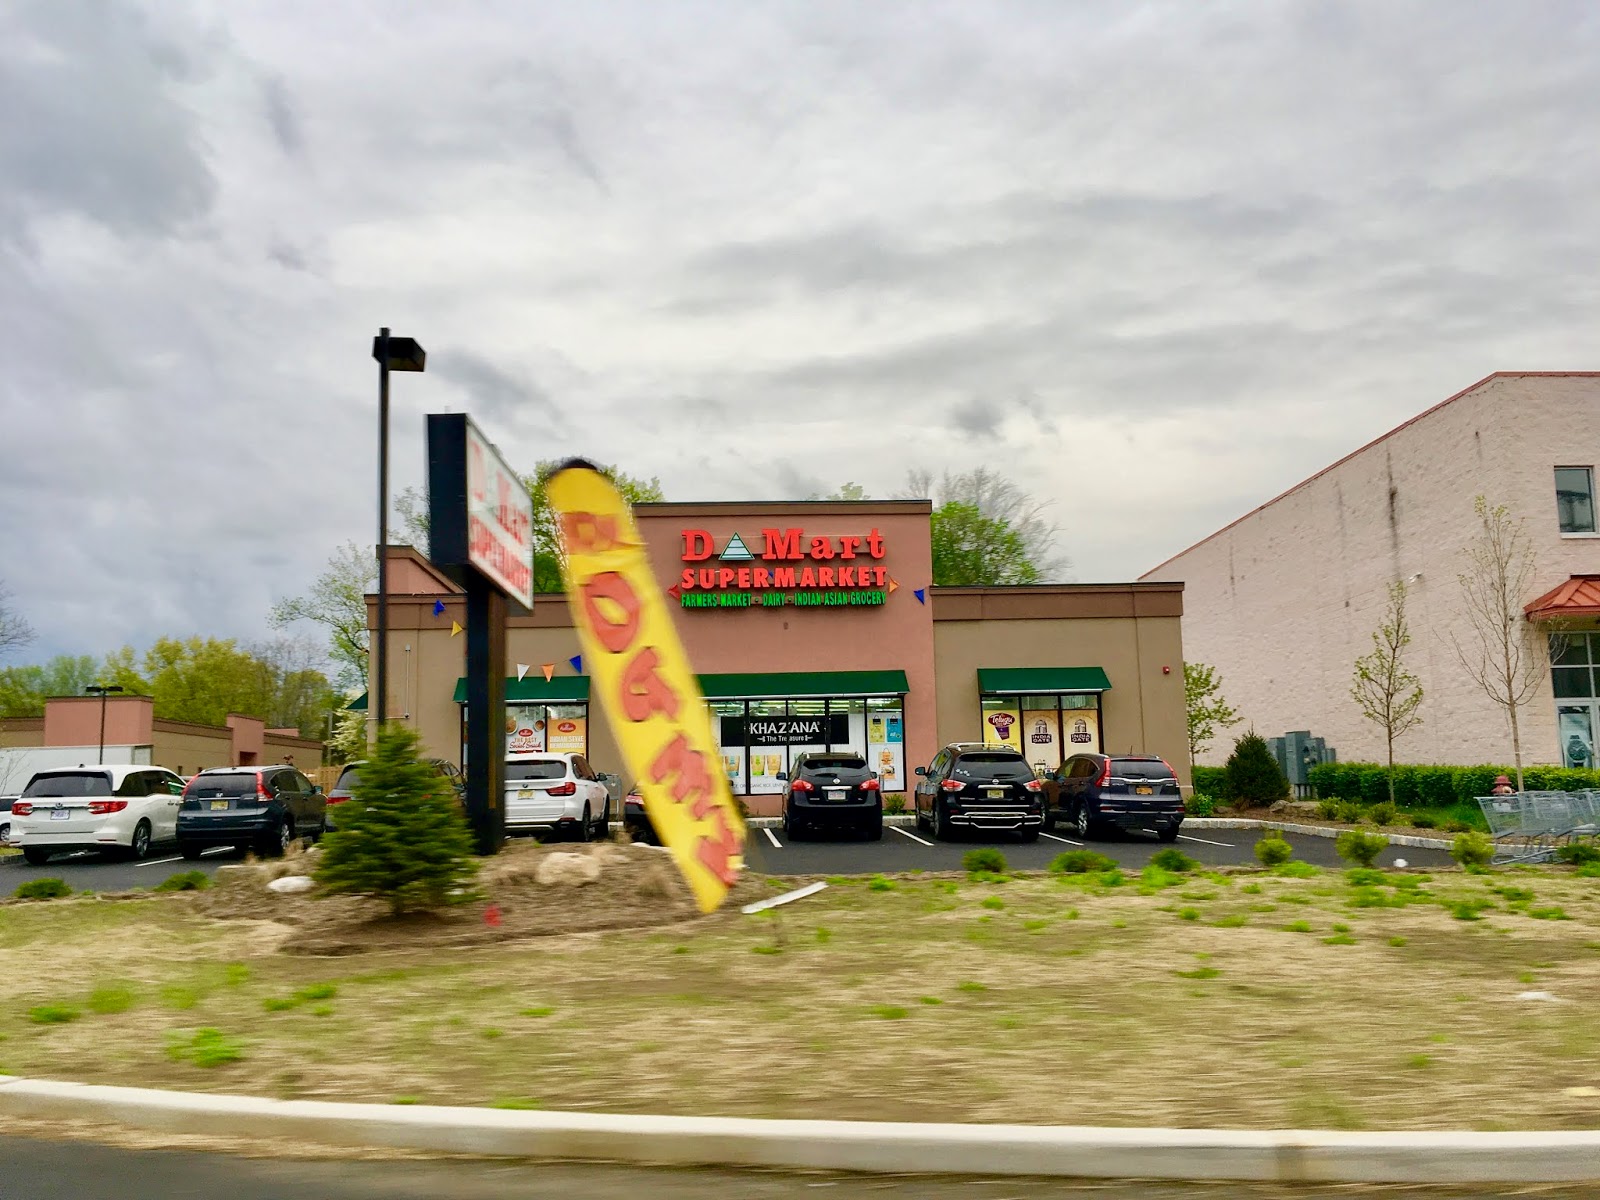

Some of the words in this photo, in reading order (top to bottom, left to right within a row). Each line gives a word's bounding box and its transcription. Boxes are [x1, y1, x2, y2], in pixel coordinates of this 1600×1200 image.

[761, 528, 886, 560] Mart
[681, 566, 887, 589] SUPERMARKET
[681, 593, 718, 608] FARMERS
[720, 593, 751, 607] MARKET
[762, 592, 786, 606] DAIRY
[794, 592, 822, 606] INDIAN
[824, 592, 848, 605] ASIAN
[850, 591, 887, 605] GROCERY
